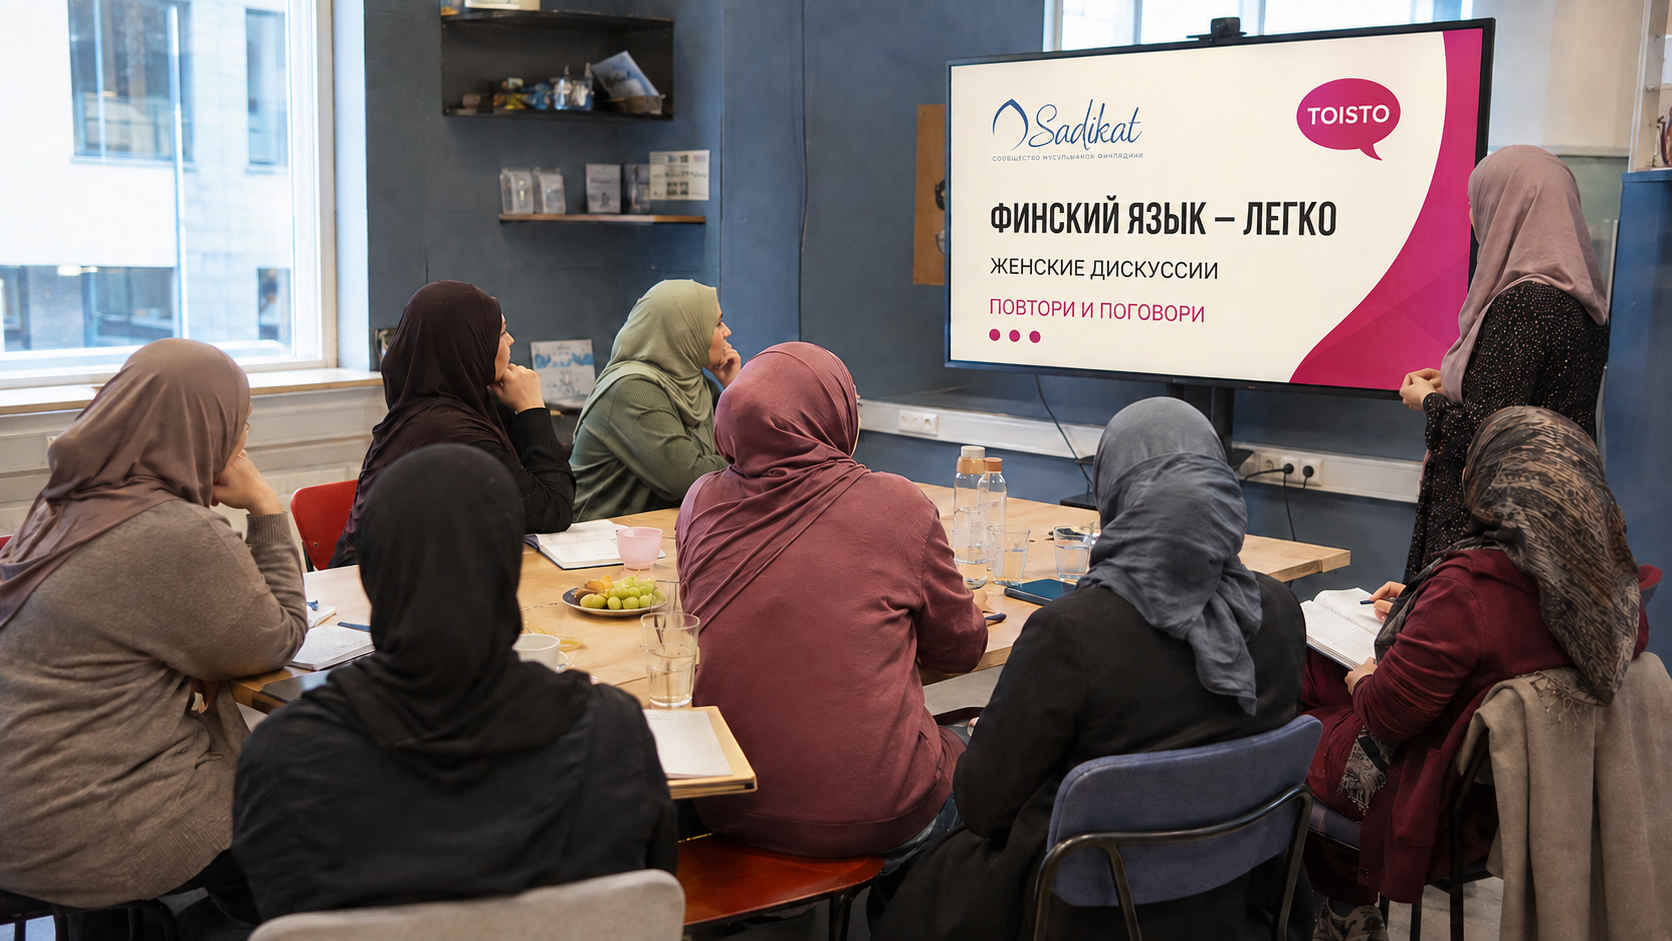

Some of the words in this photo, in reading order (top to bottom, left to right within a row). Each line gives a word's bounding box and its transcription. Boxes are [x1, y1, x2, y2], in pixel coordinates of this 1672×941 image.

[1028, 98, 1143, 151] Sadikat
[1307, 104, 1390, 126] TOISTO
[992, 154, 1041, 162] СООБЩЕСТВО
[990, 195, 1119, 234] ФИНСКИЙ
[1127, 201, 1207, 235] ЯЗЫК
[1242, 201, 1337, 237] ЛЕГКО
[990, 257, 1085, 277] ЖЕНСКИЕ
[1090, 259, 1218, 281] ДИСКУССИИ
[989, 298, 1075, 318] ПОВТОРИ
[1081, 302, 1094, 319] И
[1100, 302, 1205, 323] ПОГОВОРИ
